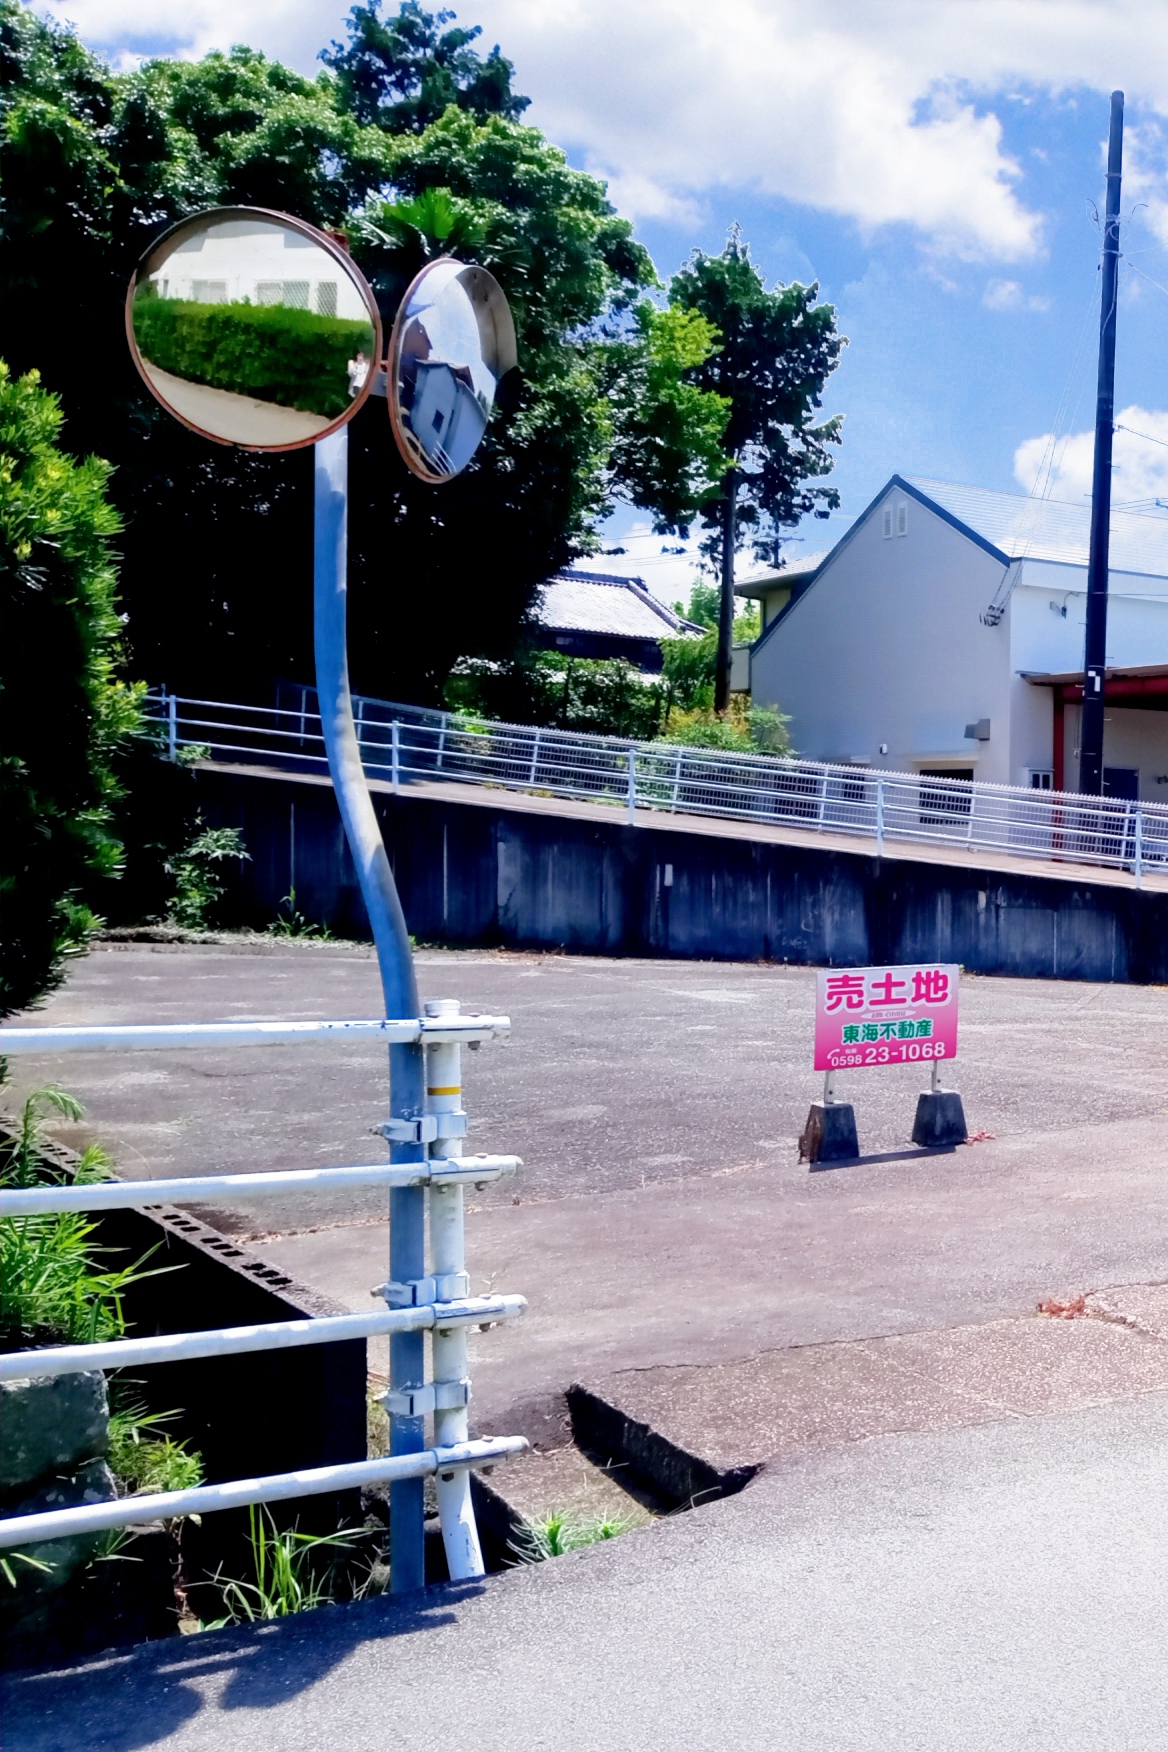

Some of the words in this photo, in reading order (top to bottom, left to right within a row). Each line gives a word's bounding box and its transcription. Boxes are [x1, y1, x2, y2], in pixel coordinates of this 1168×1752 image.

[826, 970, 949, 1011] 売土地
[843, 1019, 932, 1043] 東海不動産
[831, 1055, 862, 1066] 0598
[865, 1042, 945, 1063] 23-1068
